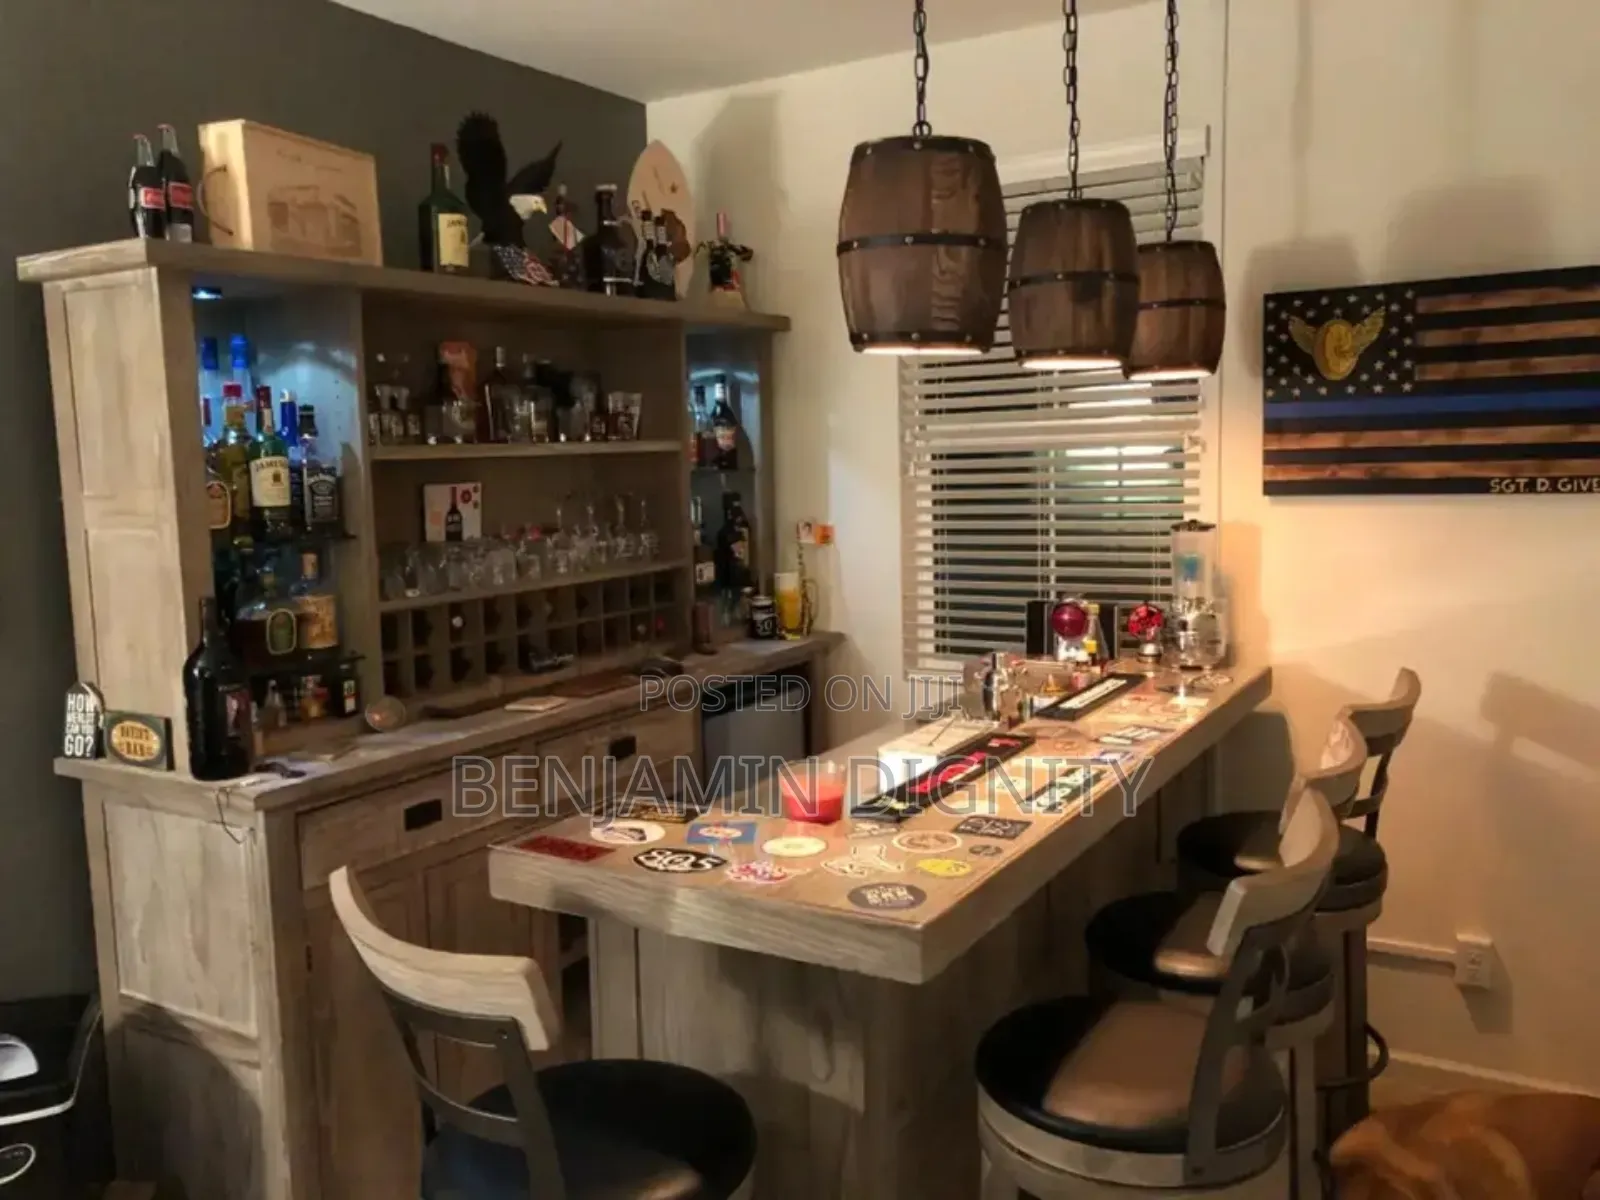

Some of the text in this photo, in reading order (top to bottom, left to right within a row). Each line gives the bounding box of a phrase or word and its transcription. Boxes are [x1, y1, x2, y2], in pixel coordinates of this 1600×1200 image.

[1490, 478, 1529, 493] SGT.
[1536, 477, 1552, 492] D.
[67, 694, 96, 712] HOW
[64, 735, 95, 758] GO?
